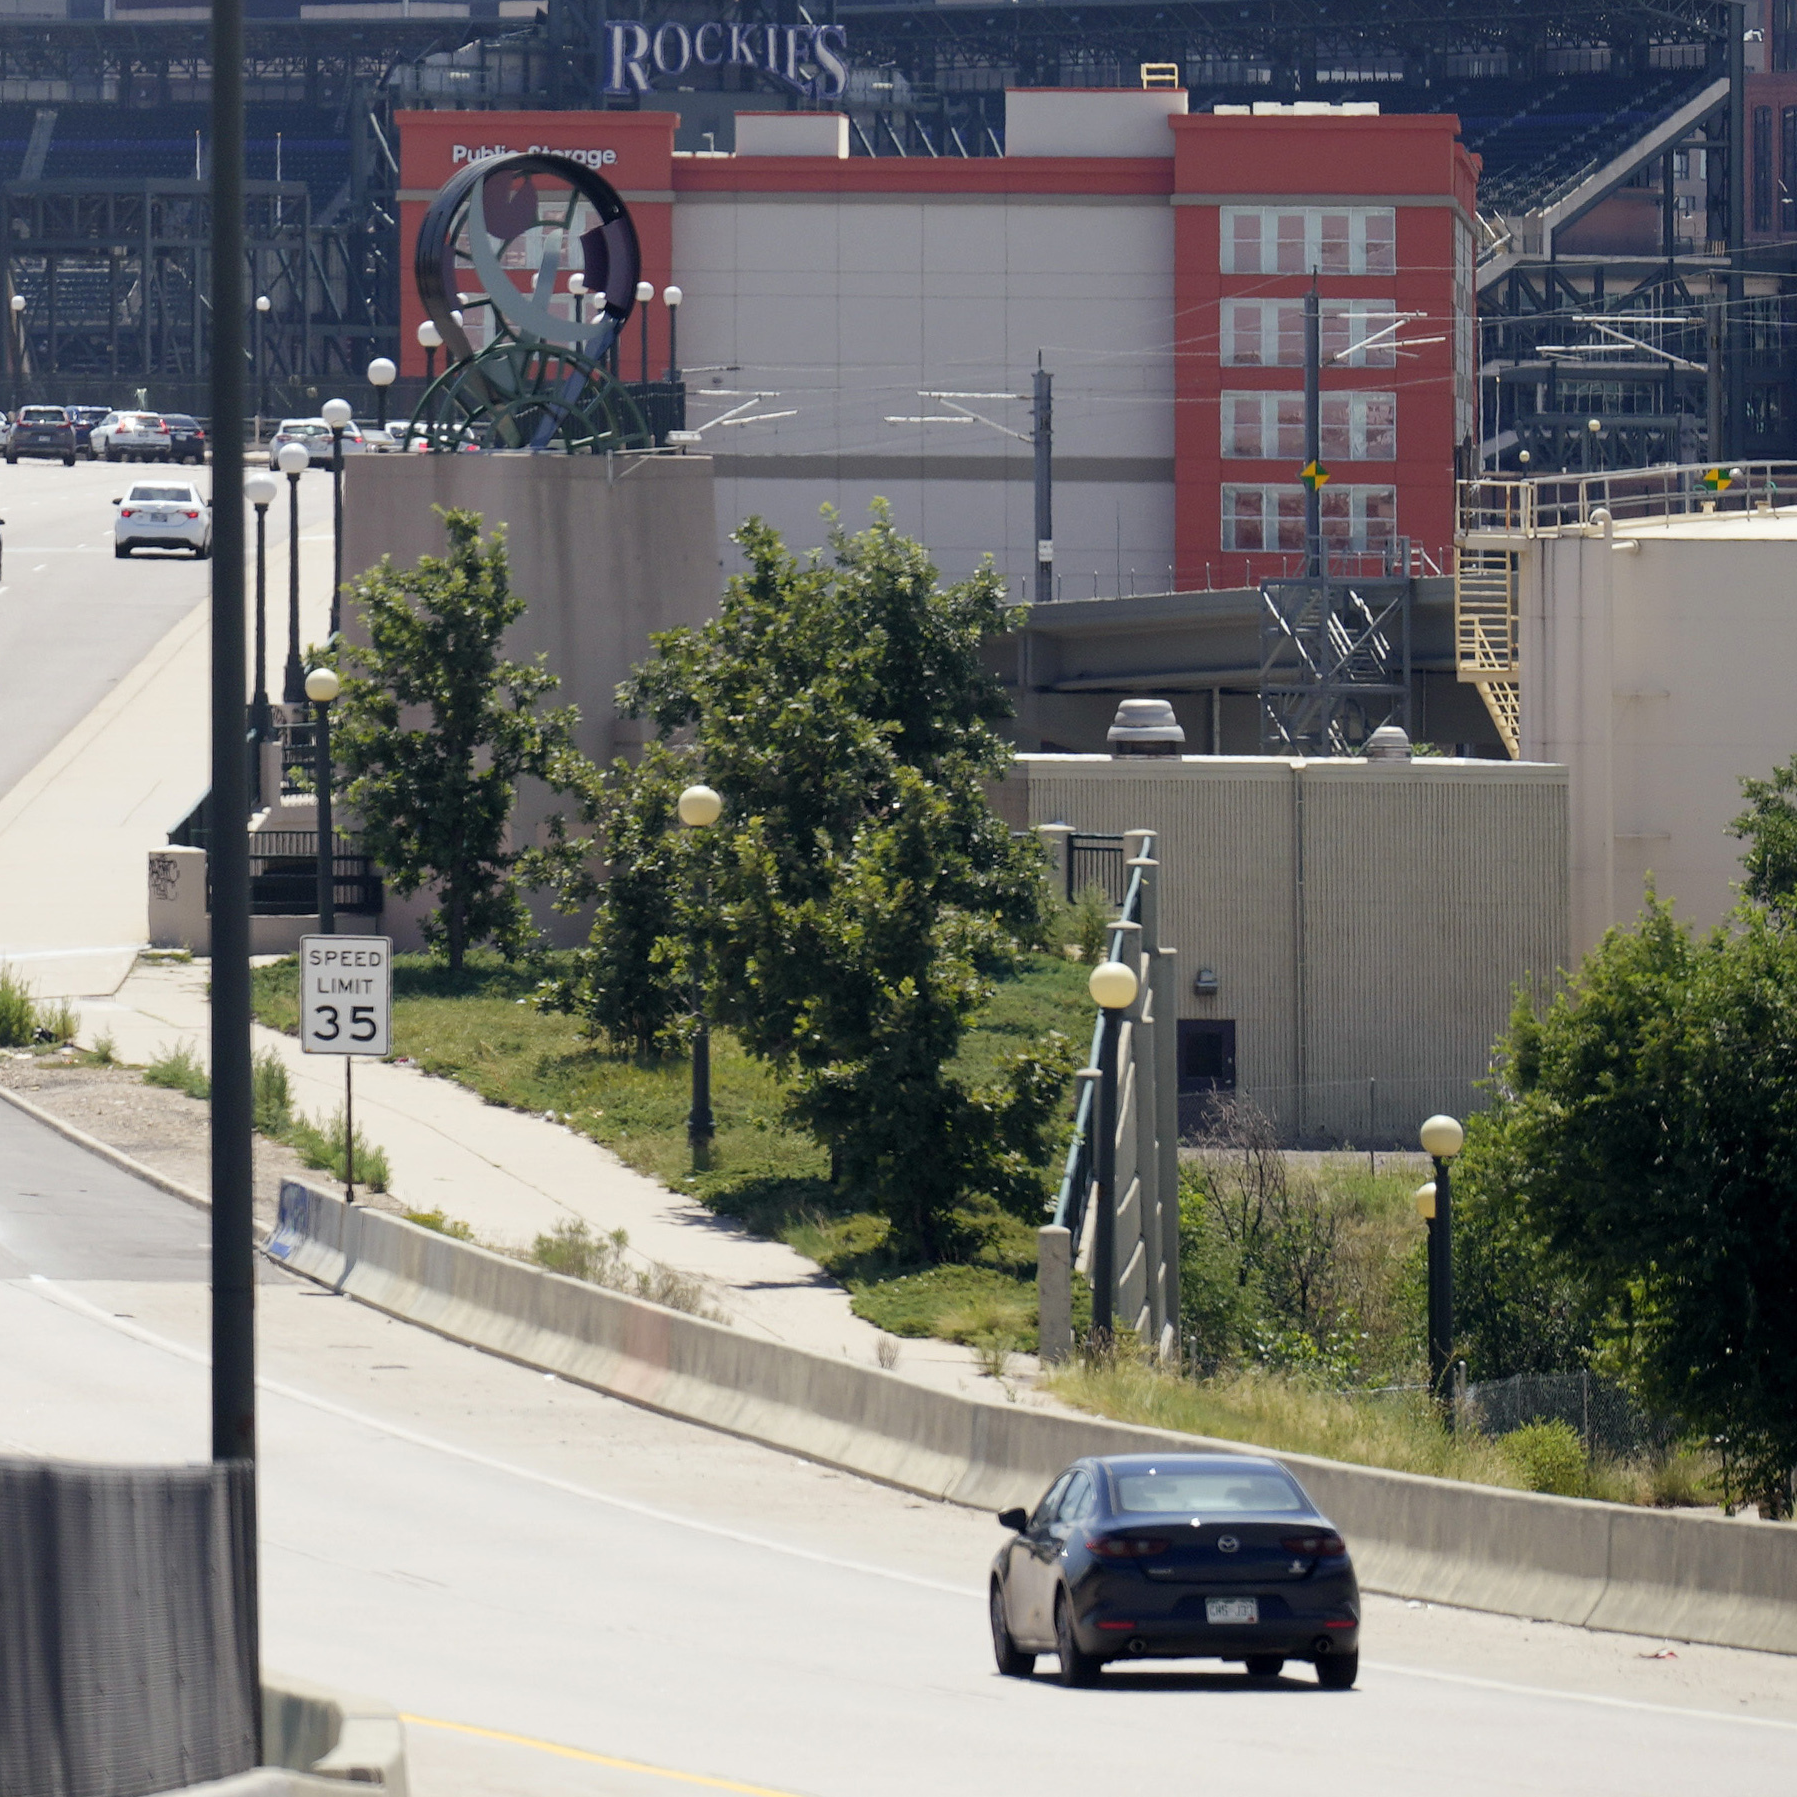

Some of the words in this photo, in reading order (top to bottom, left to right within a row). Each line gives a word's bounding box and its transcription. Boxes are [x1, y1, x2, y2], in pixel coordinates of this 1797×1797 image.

[603, 20, 849, 99] ROCKIES
[309, 949, 382, 967] SPEED
[316, 978, 373, 995] LIMIT
[313, 1005, 377, 1042] 35
